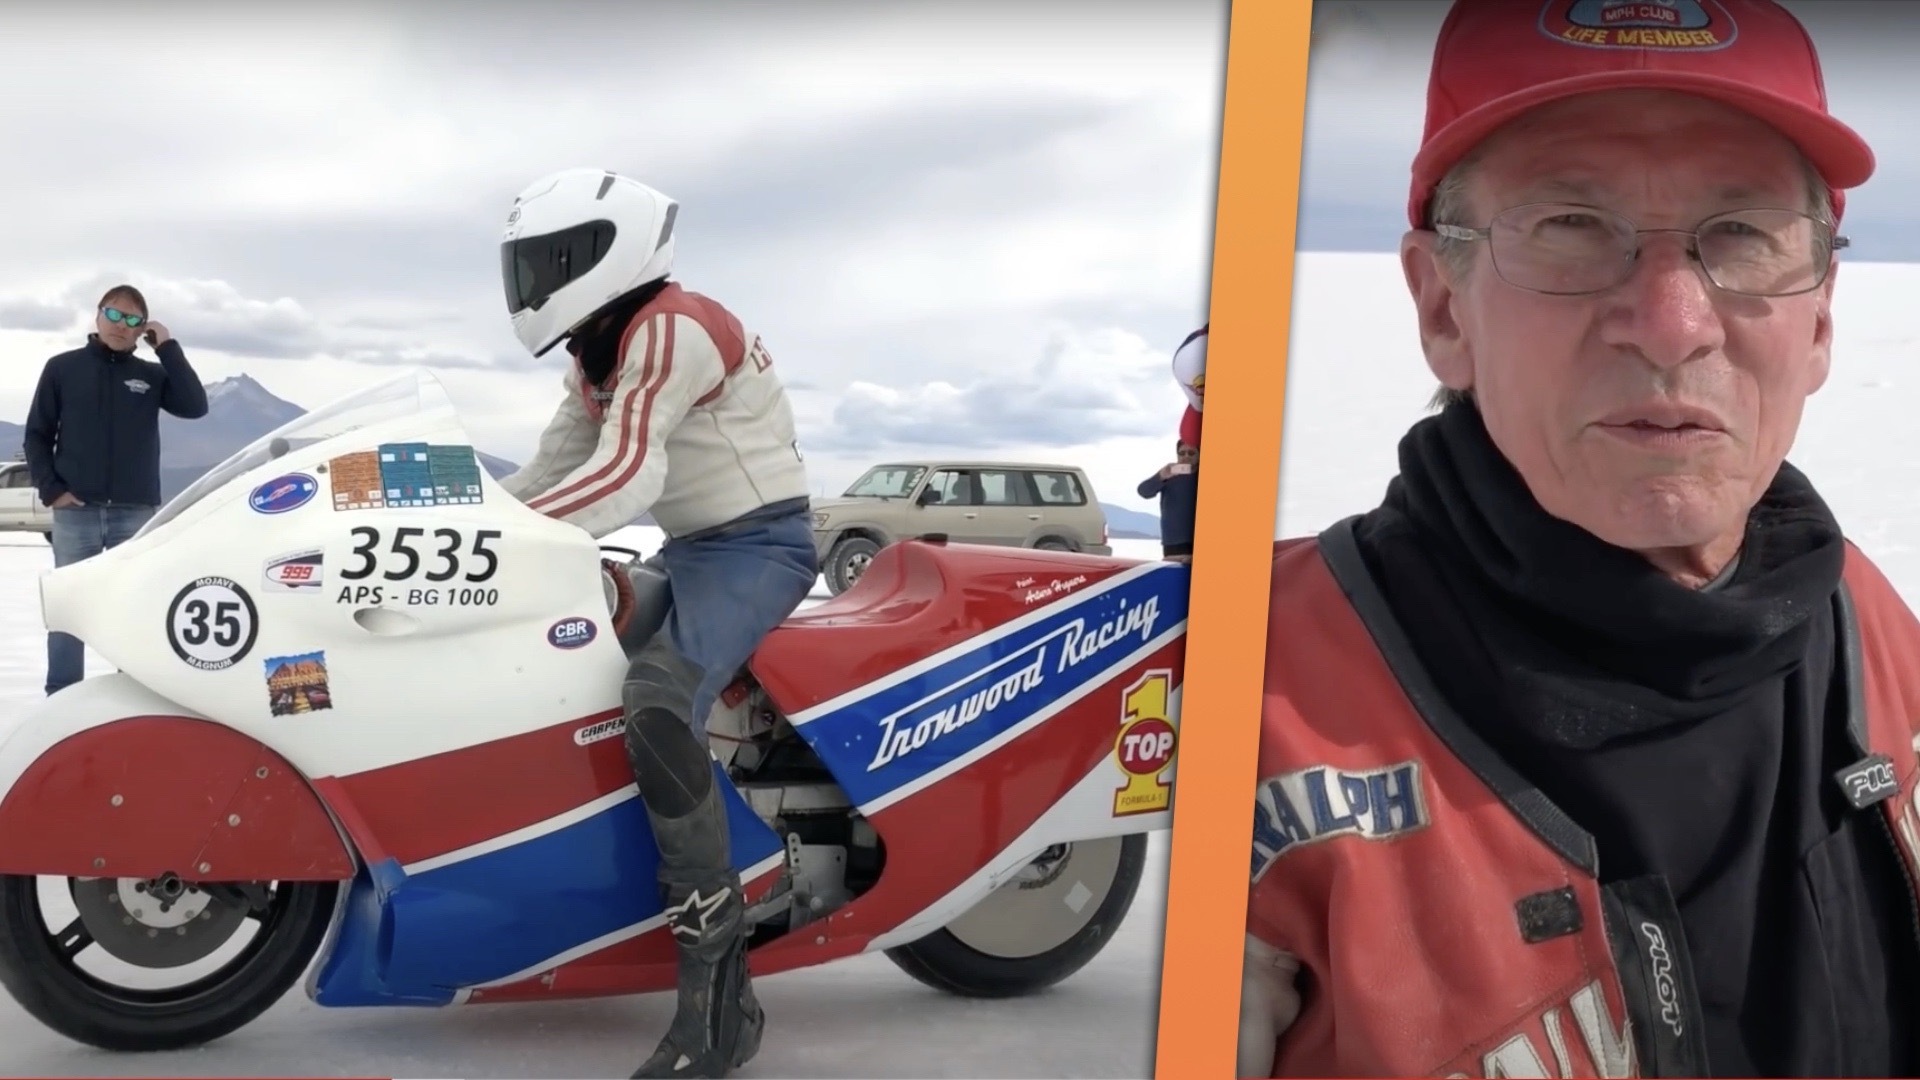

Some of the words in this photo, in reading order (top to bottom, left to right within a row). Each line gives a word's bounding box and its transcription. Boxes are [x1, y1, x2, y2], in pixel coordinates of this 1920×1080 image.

[1606, 6, 1635, 21] MPH
[1640, 6, 1676, 21] CLUB
[1562, 26, 1609, 44] LIFE
[1617, 29, 1719, 46] MEMBER
[339, 526, 502, 583] 3535
[280, 566, 314, 579] 999
[195, 577, 235, 590] MOJAVE
[337, 586, 383, 605] APS
[407, 588, 439, 605] BG
[448, 588, 499, 606] 1000
[183, 599, 241, 647] 35
[555, 621, 587, 638] CBR
[186, 656, 233, 671] MAGNUM
[867, 643, 1048, 772] Ironwood
[1057, 595, 1161, 674] Racing
[1124, 731, 1174, 762] TOP
[1641, 921, 1683, 1037] PILOT
